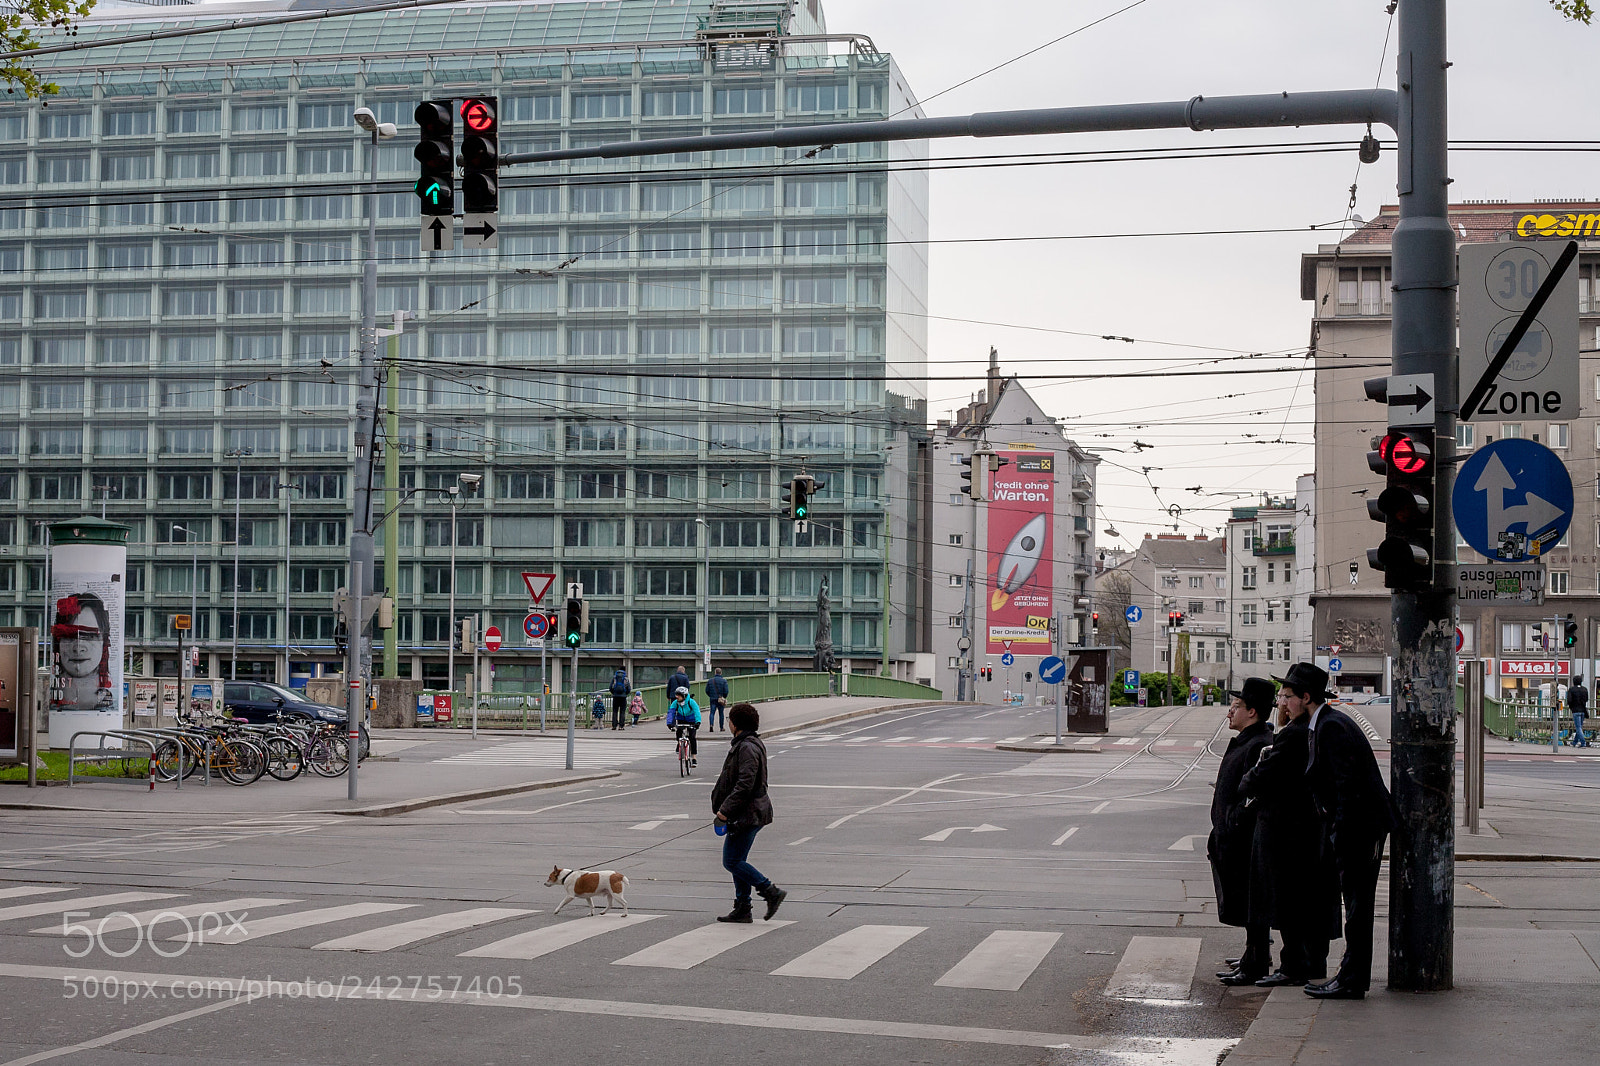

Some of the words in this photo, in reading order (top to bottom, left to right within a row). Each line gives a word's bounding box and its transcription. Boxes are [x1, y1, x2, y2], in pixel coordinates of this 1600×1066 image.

[716, 44, 770, 66] IBM
[1498, 259, 1540, 299] 30
[1477, 384, 1561, 415] Zone
[994, 481, 1022, 489] Kredit
[1024, 482, 1049, 490] ohne
[992, 489, 1049, 502] Warten.
[1029, 618, 1046, 629] OK
[1508, 662, 1562, 674] Miele
